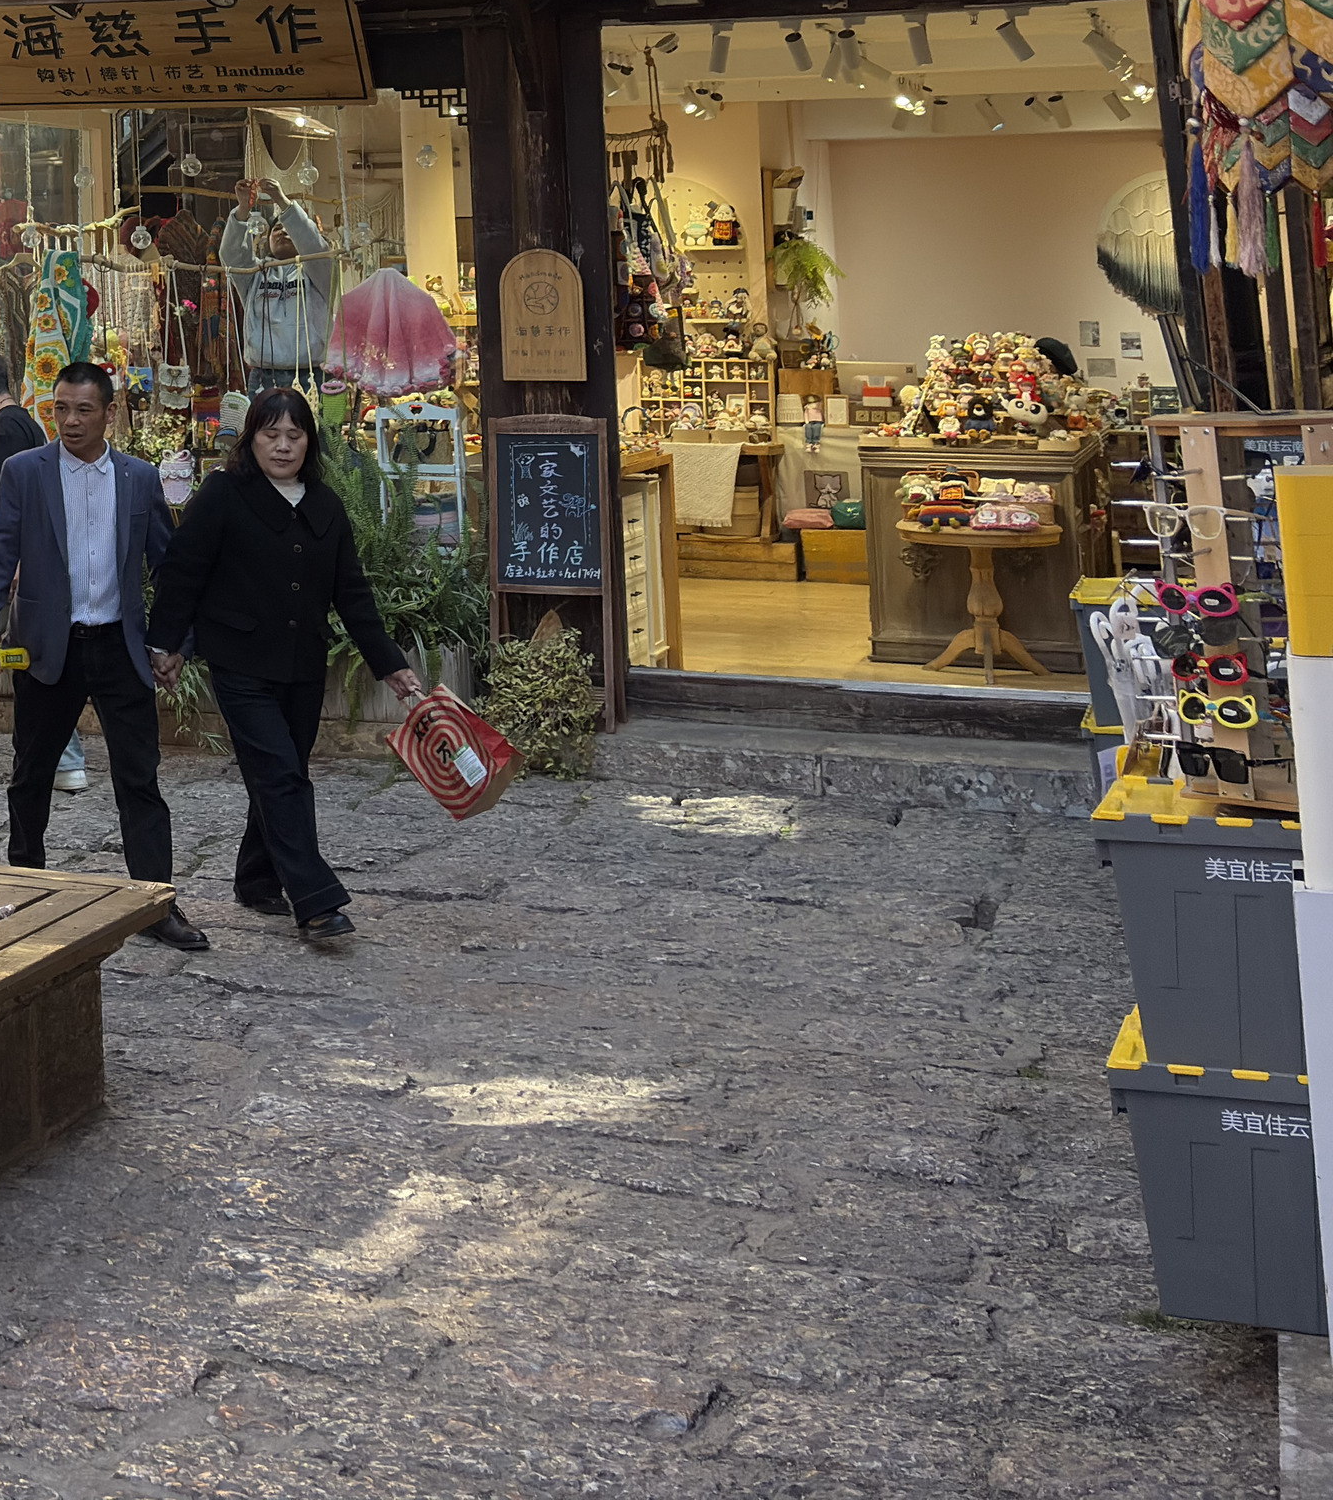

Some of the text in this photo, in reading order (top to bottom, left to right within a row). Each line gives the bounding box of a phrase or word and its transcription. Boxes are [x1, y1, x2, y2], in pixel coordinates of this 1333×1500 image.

[2, 2, 324, 60] 海慈手作
[164, 64, 204, 81] 布艺
[215, 64, 305, 78] Handmade
[536, 451, 564, 541] 一家文艺的
[509, 540, 584, 566] 手作店
[415, 706, 441, 743] KFC
[1204, 856, 1294, 883] 美宜佳云
[1221, 1108, 1310, 1139] 美宜佳云
